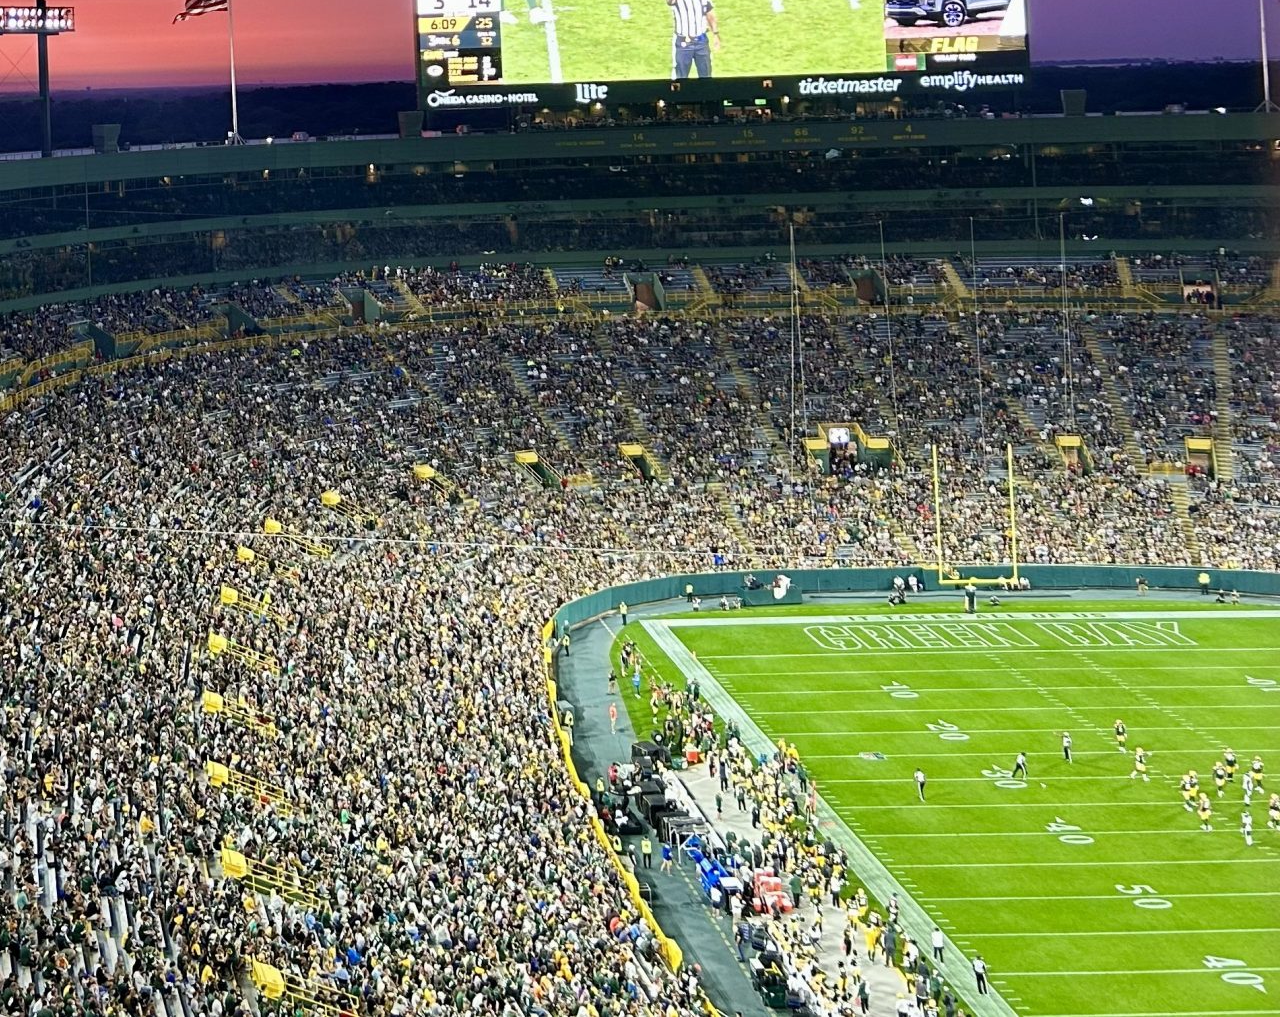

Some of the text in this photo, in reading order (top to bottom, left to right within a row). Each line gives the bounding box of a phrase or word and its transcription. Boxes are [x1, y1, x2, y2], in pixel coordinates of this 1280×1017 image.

[430, 19, 458, 30] 6:09
[930, 36, 979, 52] FLAG
[575, 83, 609, 103] Lite
[798, 77, 902, 95] ticketmaster
[851, 125, 864, 135] 92
[802, 621, 1200, 651] GREEN BAY
[879, 684, 921, 699] 10
[925, 721, 971, 741] 20
[980, 768, 1029, 789] 30
[1045, 822, 1096, 845] 40
[1114, 884, 1174, 910] 50
[1202, 955, 1265, 985] 40
